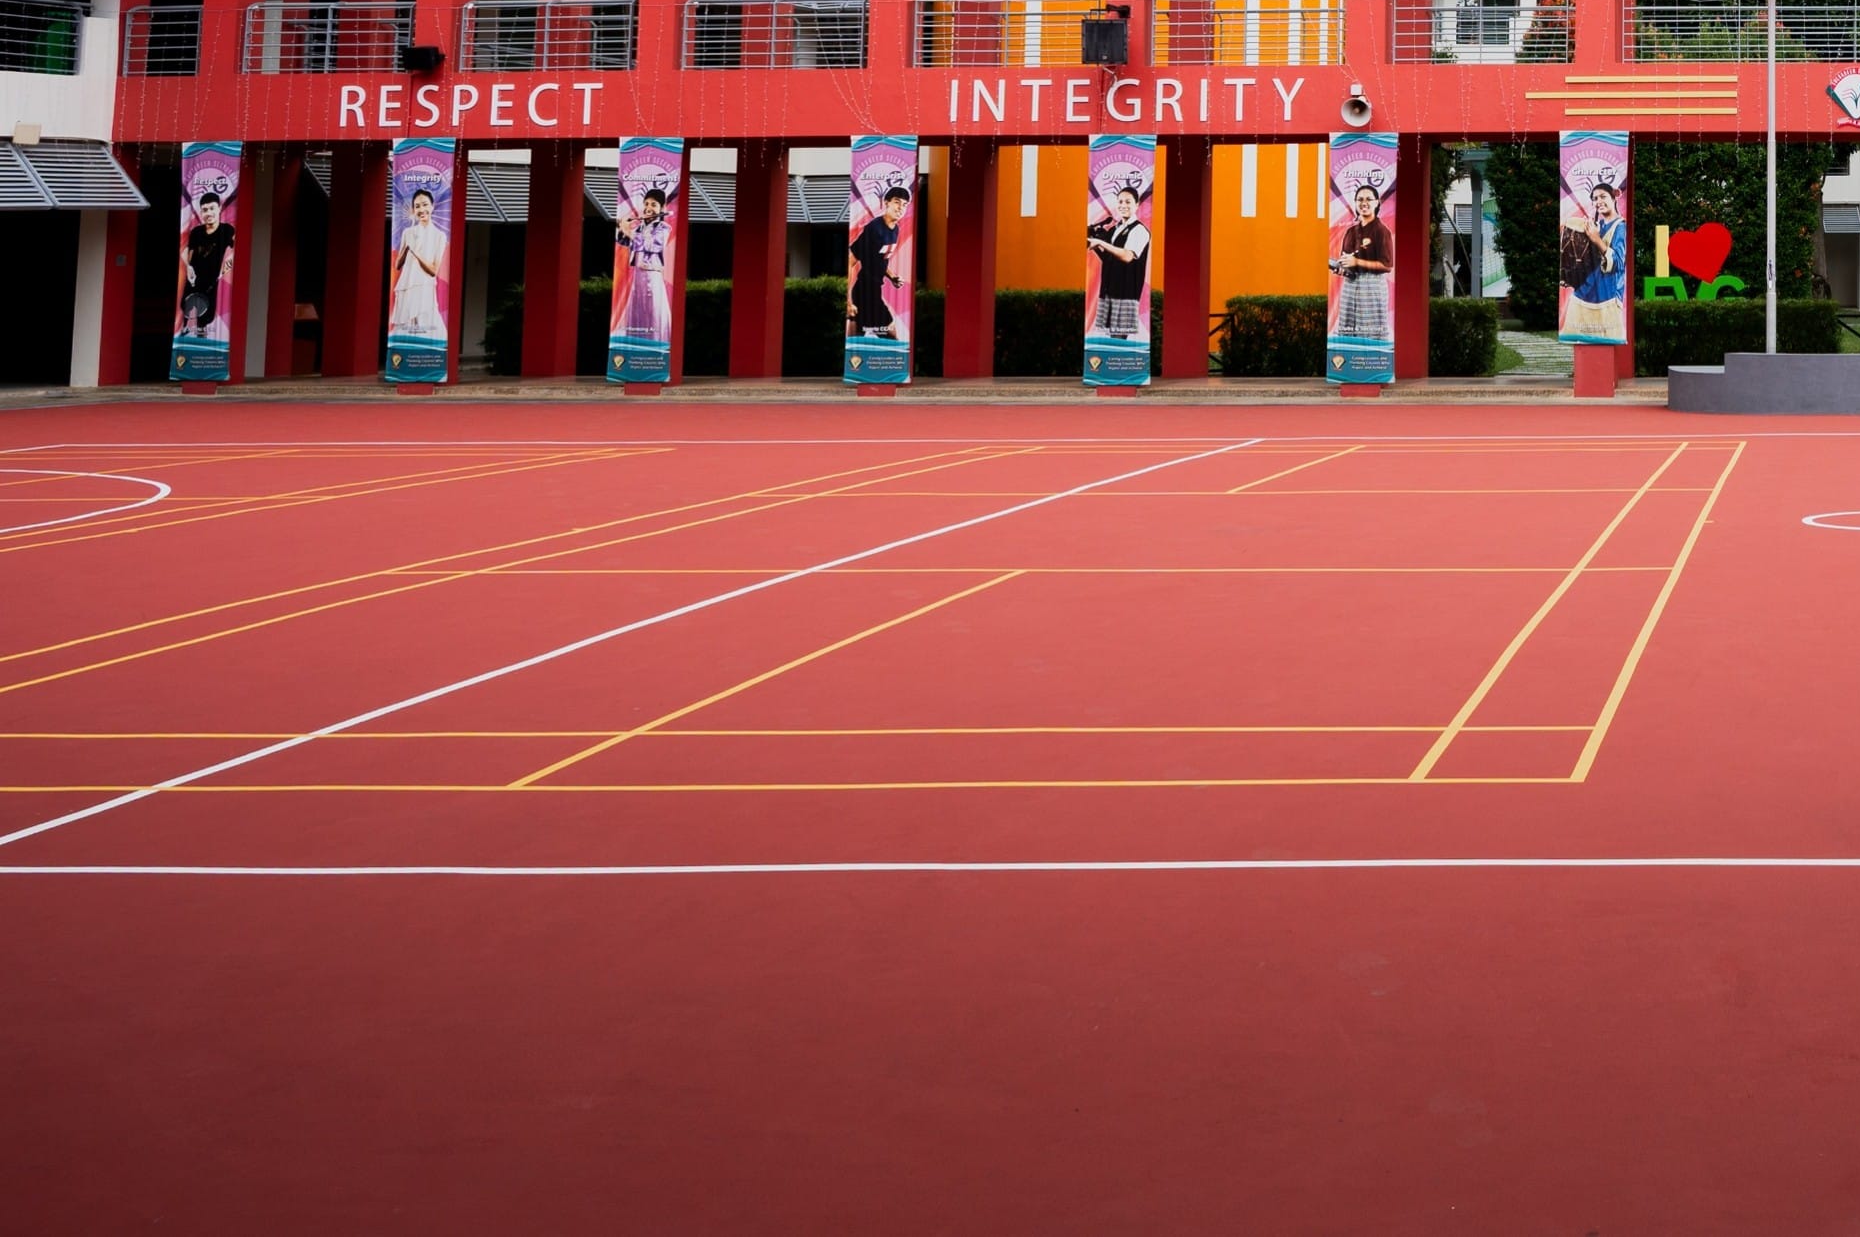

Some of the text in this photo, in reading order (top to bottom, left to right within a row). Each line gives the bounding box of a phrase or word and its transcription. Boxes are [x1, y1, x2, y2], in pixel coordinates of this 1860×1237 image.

[339, 83, 604, 128] RESPECT
[950, 78, 1305, 122] INTEGRITY
[404, 174, 441, 184] Integrity
[1102, 171, 1142, 181] Dynamic
[1344, 169, 1384, 180] Thinking
